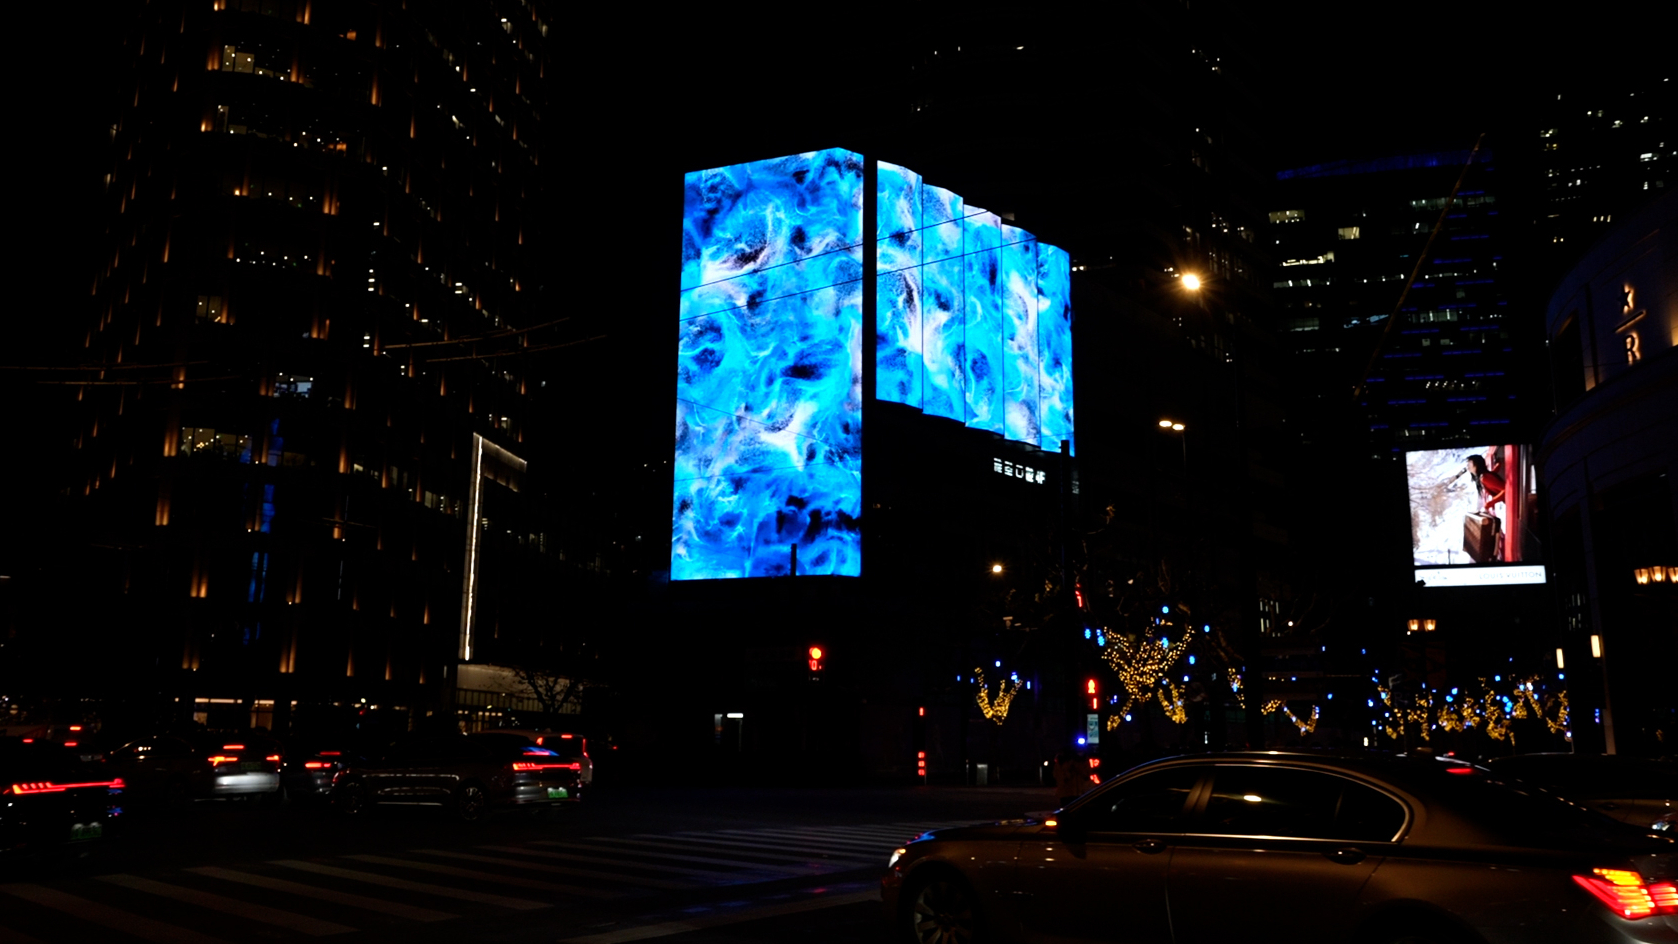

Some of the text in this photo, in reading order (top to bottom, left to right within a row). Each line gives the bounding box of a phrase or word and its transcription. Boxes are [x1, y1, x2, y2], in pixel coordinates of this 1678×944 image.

[1624, 333, 1641, 365] R
[1479, 571, 1542, 581] LOUIS VUITTON
